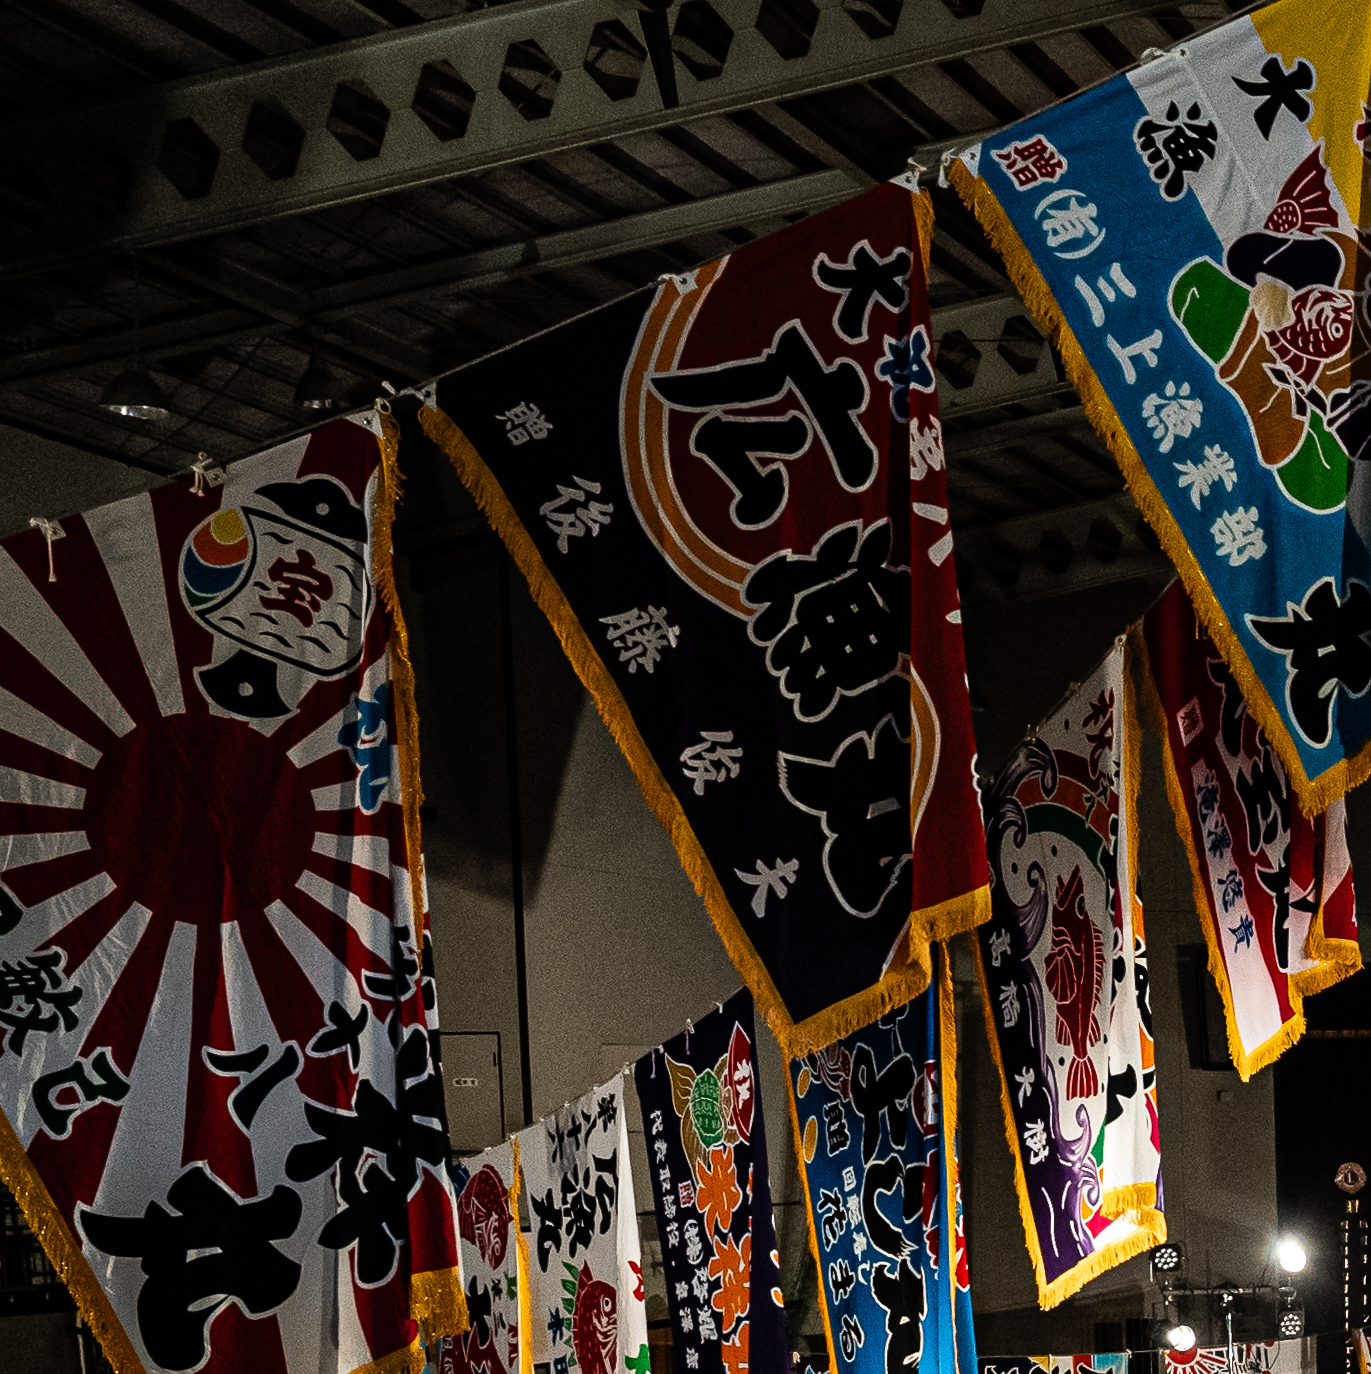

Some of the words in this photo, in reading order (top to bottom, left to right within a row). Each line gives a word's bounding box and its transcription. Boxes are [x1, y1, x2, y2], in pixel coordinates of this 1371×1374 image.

[990, 132, 1068, 191] 贈
[1132, 56, 1317, 202] 大漁
[1034, 186, 1268, 568] (有)三上漁業部
[547, 1092, 618, 1163] 第八十六
[818, 1187, 864, 1363] 花まる
